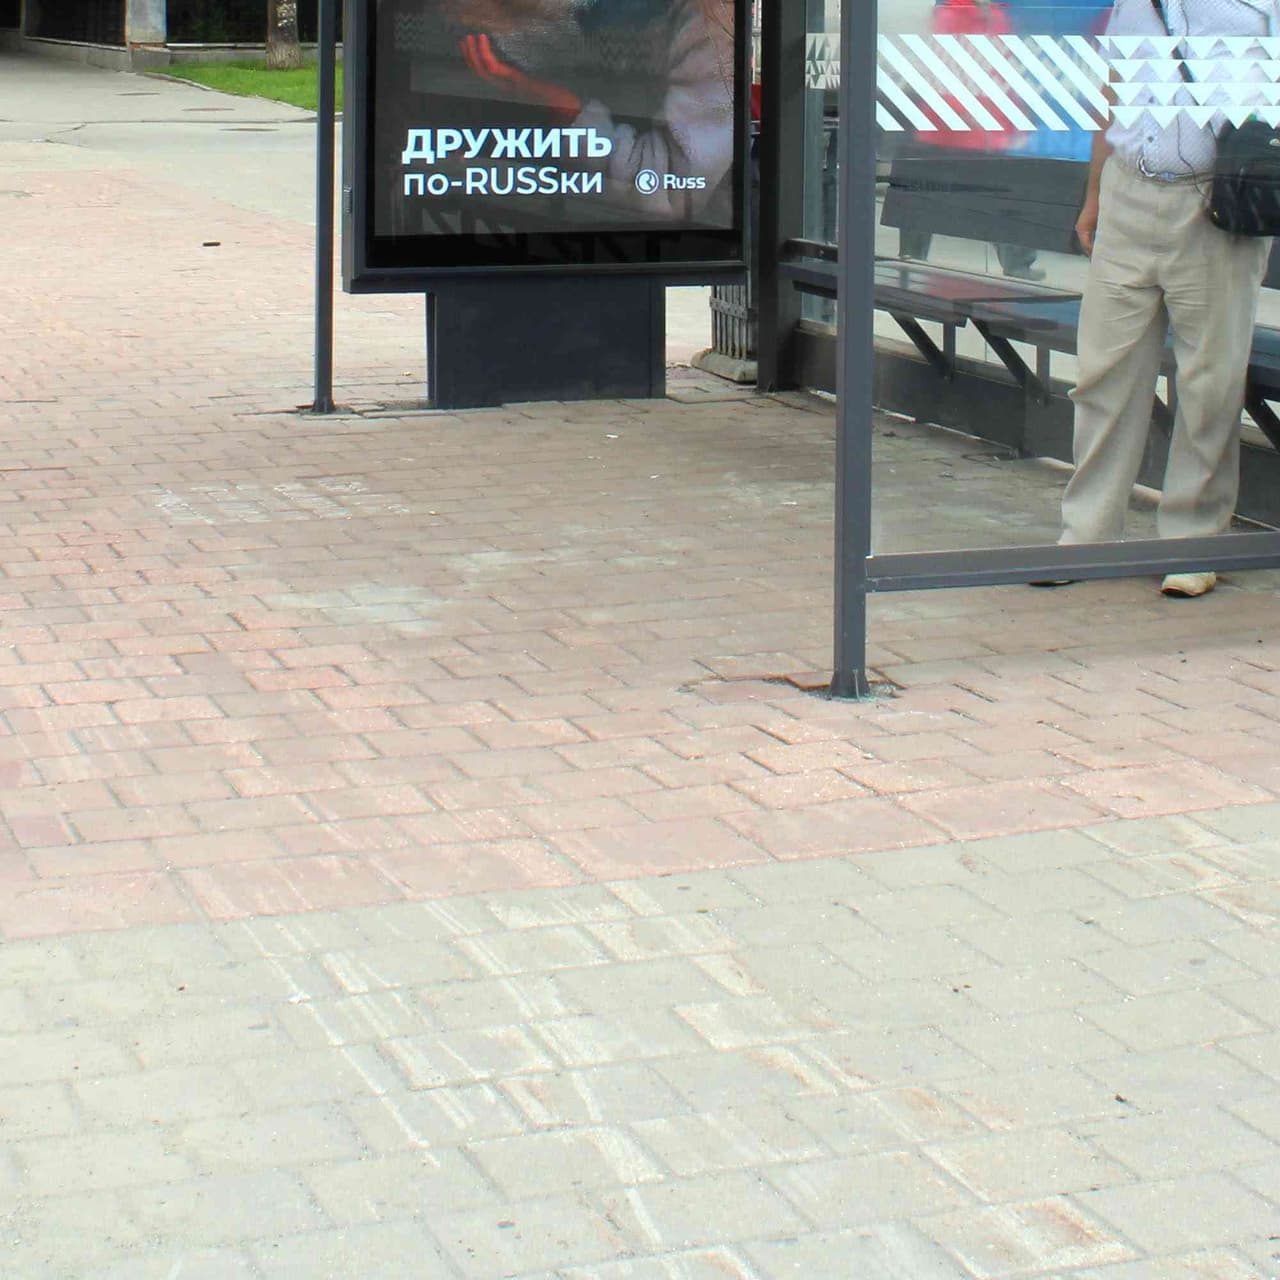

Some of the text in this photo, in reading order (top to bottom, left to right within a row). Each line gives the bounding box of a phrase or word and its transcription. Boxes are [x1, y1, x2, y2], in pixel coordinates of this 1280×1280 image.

[401, 127, 613, 165] ДРУЖИТЬ
[403, 166, 603, 196] по-RUSSки
[663, 173, 706, 189] Russ
